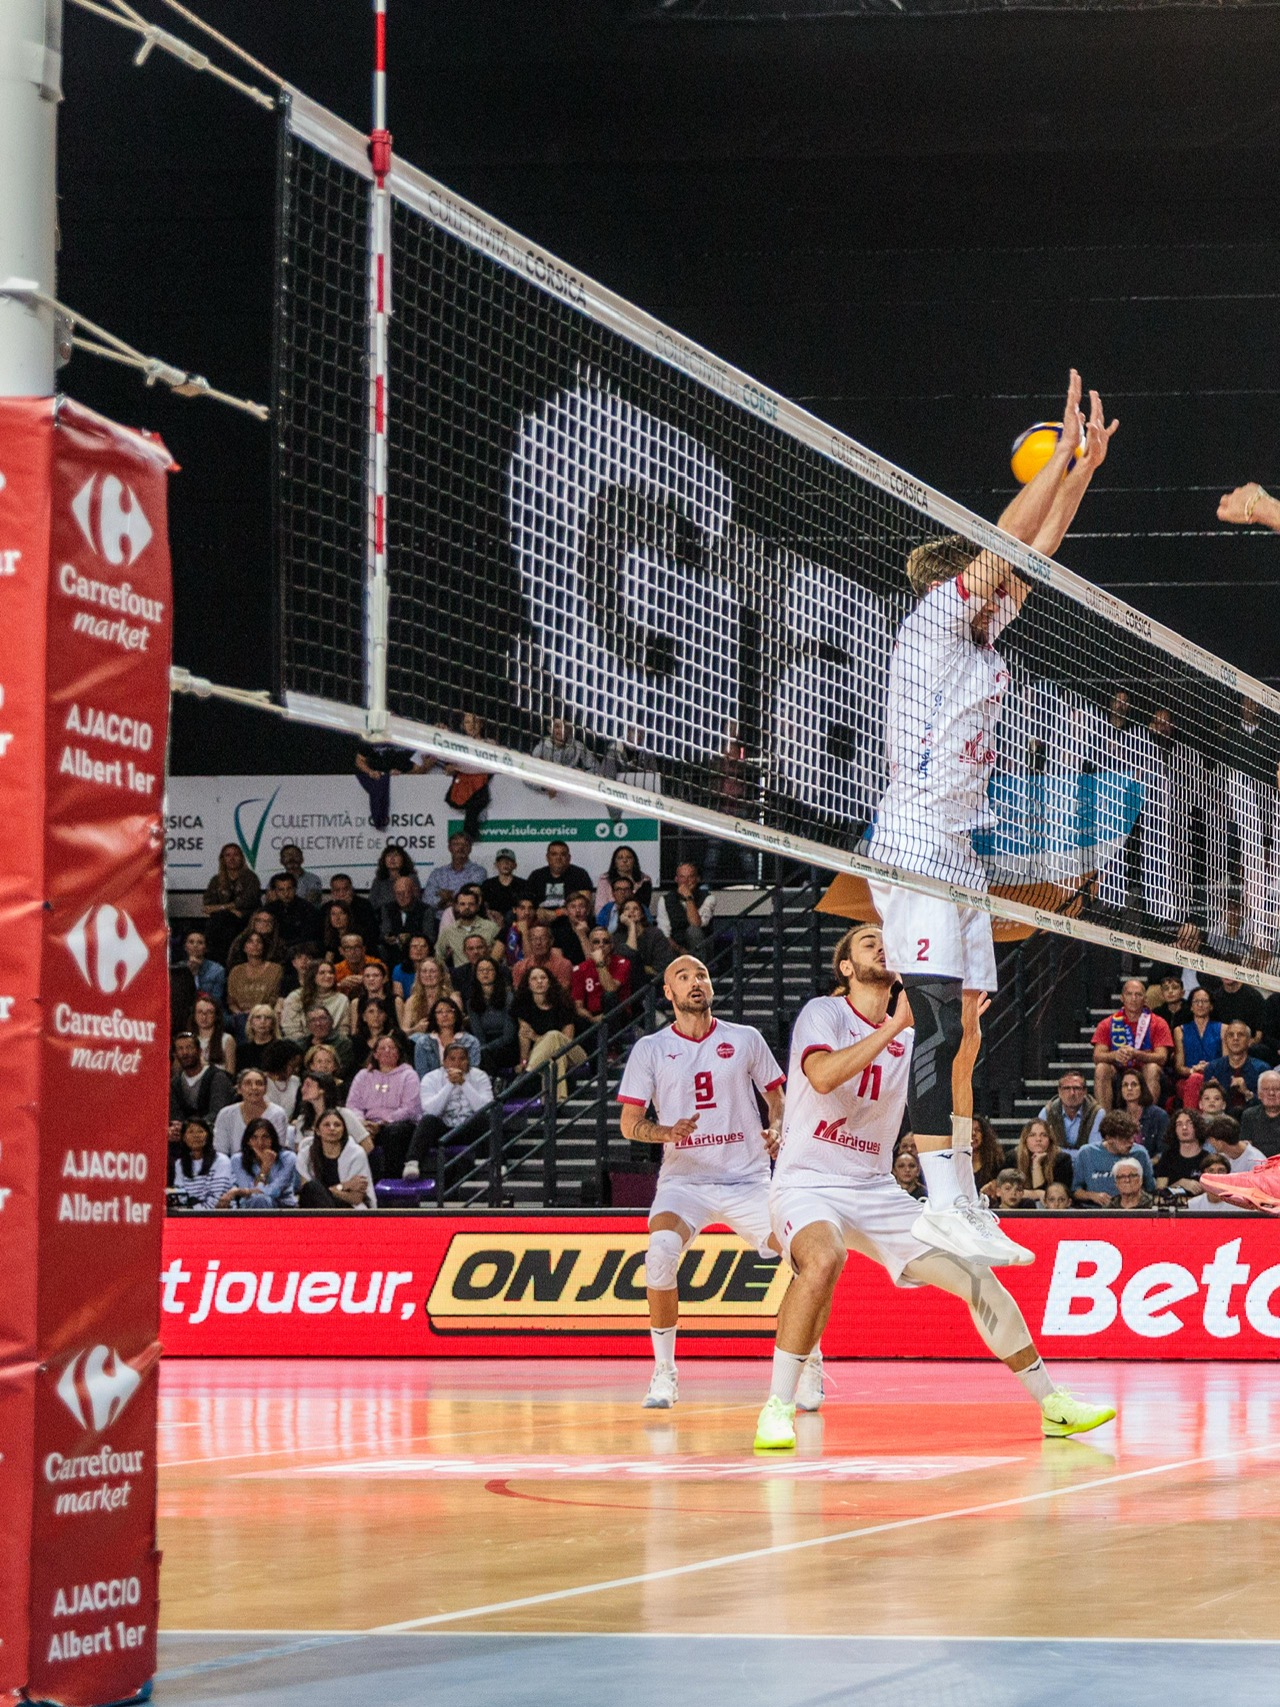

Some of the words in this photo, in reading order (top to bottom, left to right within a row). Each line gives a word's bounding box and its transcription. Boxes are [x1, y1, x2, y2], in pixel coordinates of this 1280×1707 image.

[526, 250, 587, 308] CORSICA
[743, 383, 779, 421] CORSE
[890, 471, 929, 511] CORSICA
[58, 562, 164, 624] Carrefour
[73, 610, 150, 654] market
[65, 703, 153, 752] AJACCIO
[60, 746, 123, 788] Albert
[916, 938, 930, 962] 2
[55, 1002, 156, 1043] Carrefour
[70, 1046, 143, 1076] market
[857, 1061, 883, 1101] 11
[694, 1070, 715, 1103] 9
[813, 1117, 881, 1154] Martigues
[62, 1150, 148, 1182] AJACCIO
[58, 1193, 121, 1223] Albert
[189, 1258, 417, 1323] joueur,
[450, 1249, 573, 1302] ON
[44, 1445, 145, 1483] Carrefour
[55, 1480, 132, 1516] market
[53, 1576, 140, 1618] AJACCIO
[48, 1627, 111, 1663] Albert
[117, 1620, 147, 1651] 1er
